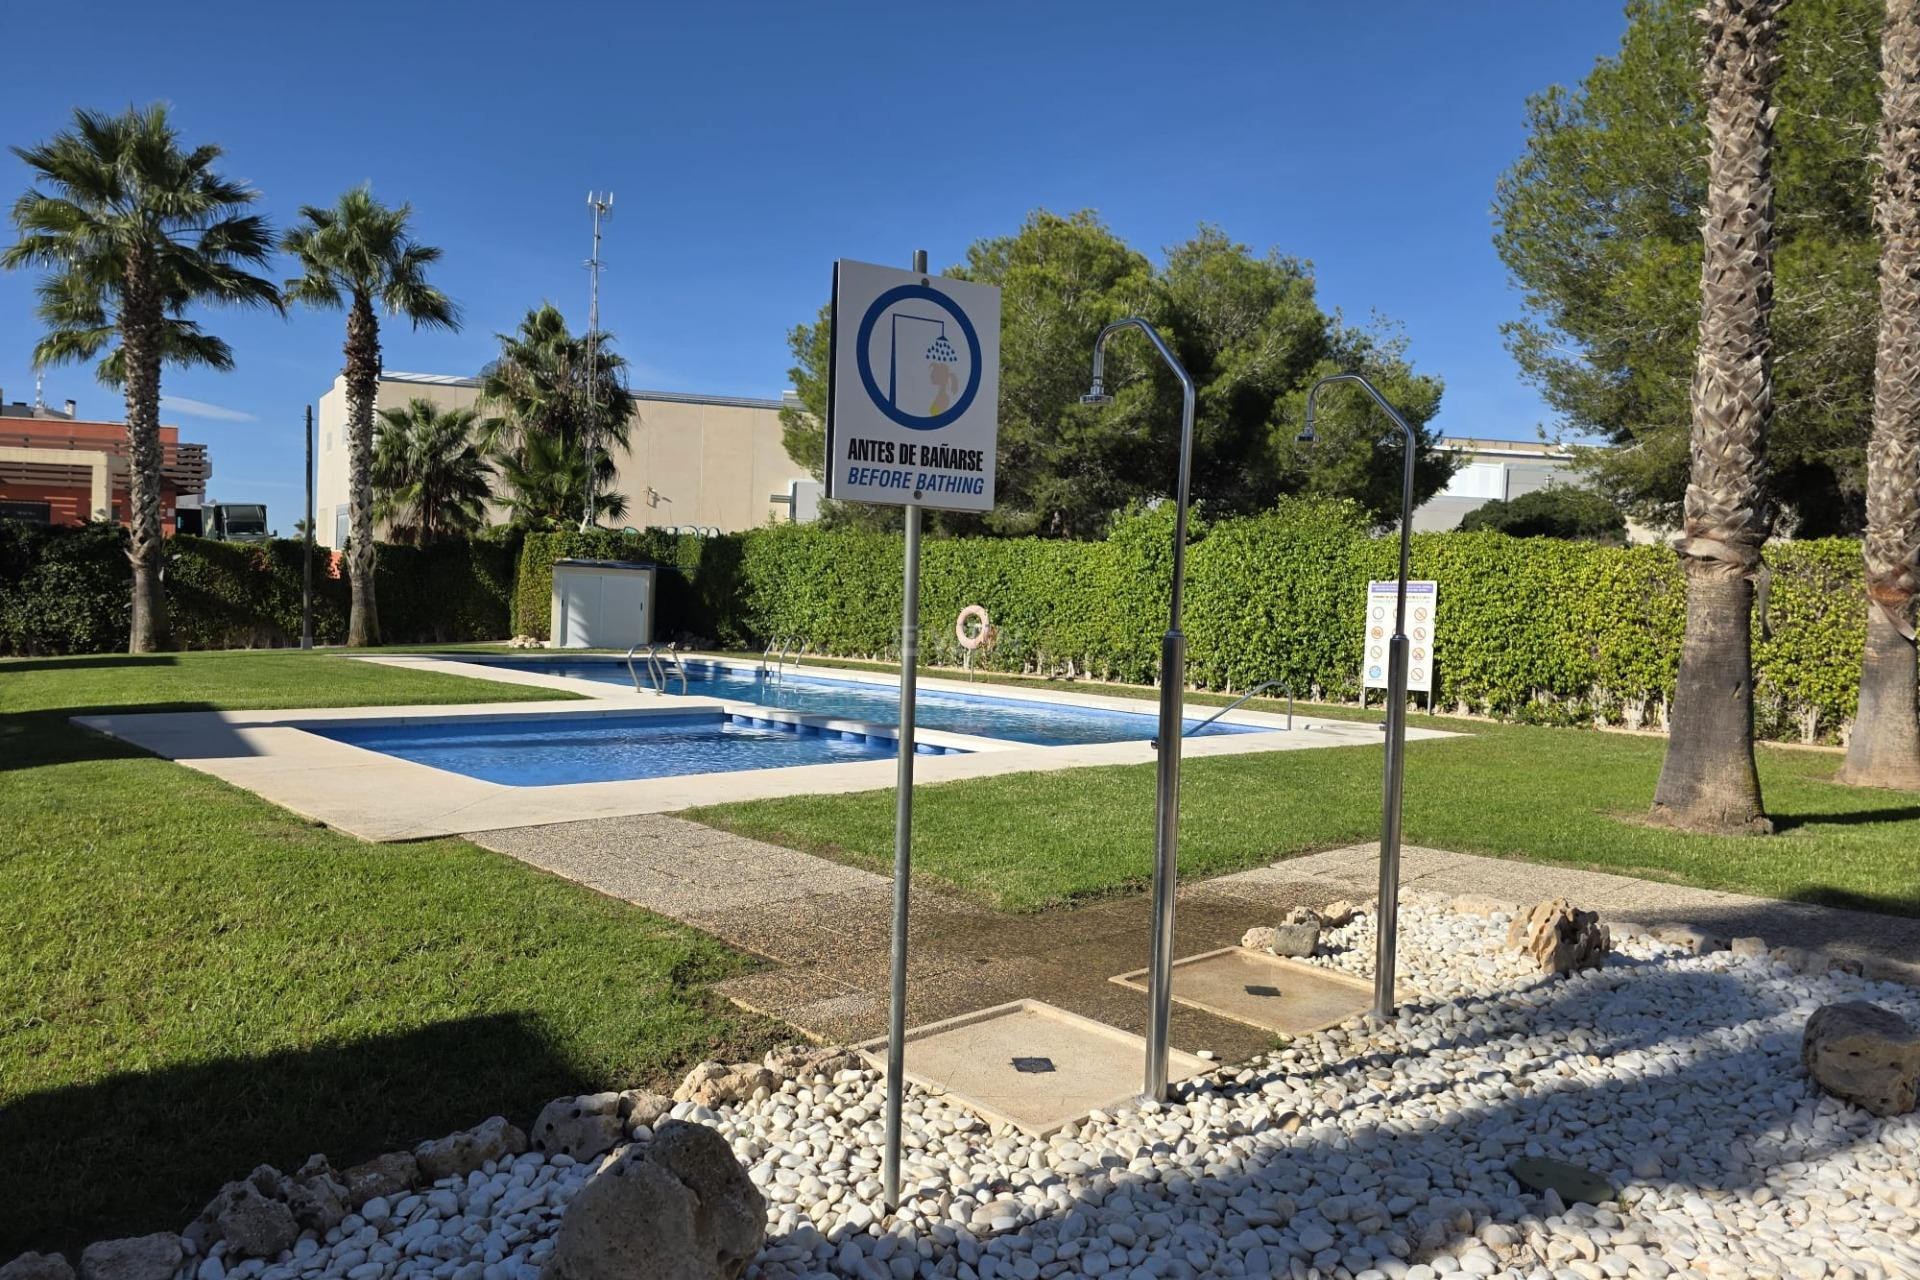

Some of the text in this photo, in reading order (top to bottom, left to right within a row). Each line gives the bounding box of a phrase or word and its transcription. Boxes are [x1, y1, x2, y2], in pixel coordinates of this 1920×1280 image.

[848, 438, 984, 472] ANTES DE BAÑARSE
[848, 466, 985, 494] BEFORE BATHING
